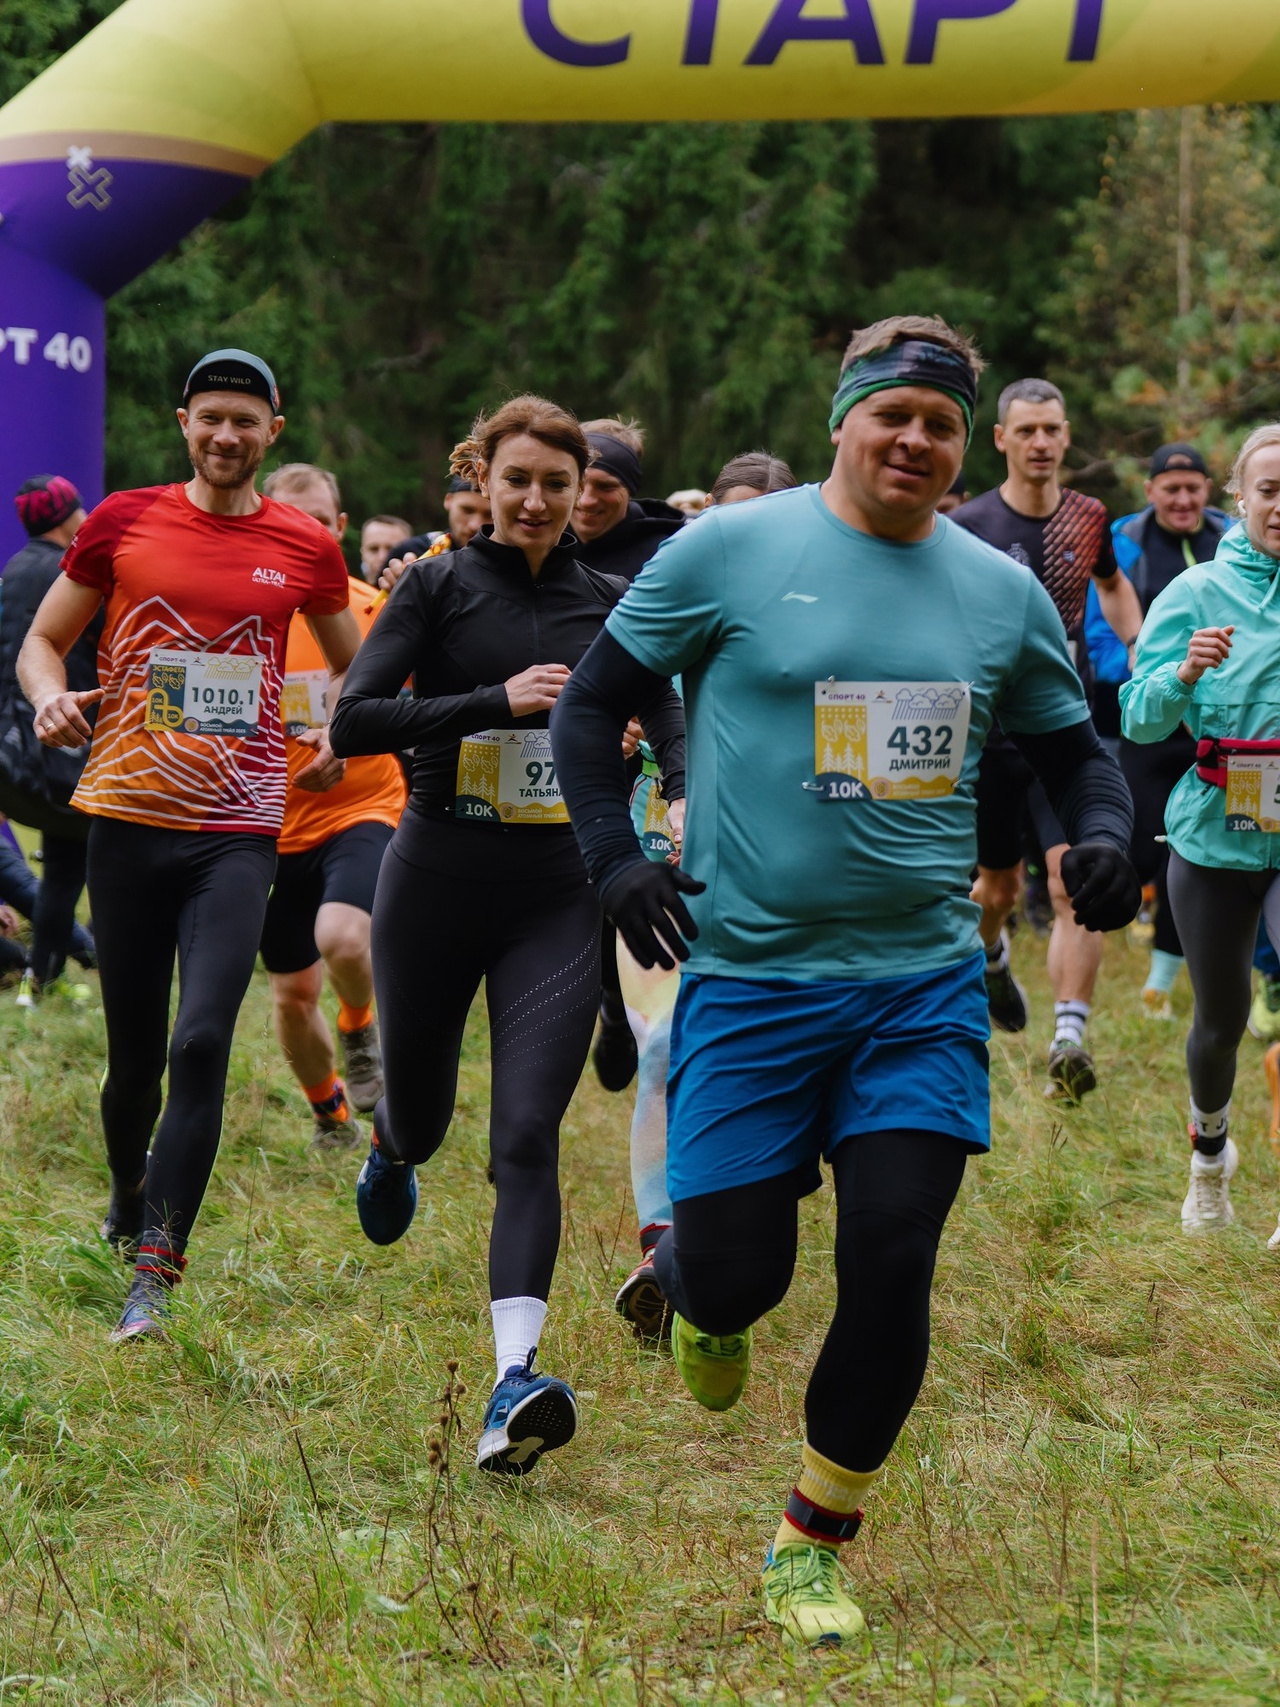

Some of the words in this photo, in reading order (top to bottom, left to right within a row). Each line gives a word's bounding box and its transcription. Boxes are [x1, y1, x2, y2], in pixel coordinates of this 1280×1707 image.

[43, 332, 92, 373] 40
[252, 566, 286, 584] ALTAI
[153, 665, 185, 673] ЭСТАФЕТА
[192, 686, 254, 705] 1010.1
[203, 705, 243, 715] АНДРЕЙ
[886, 725, 953, 756] 432
[889, 756, 950, 771] ДМИТРИЙ
[525, 761, 557, 786] 97
